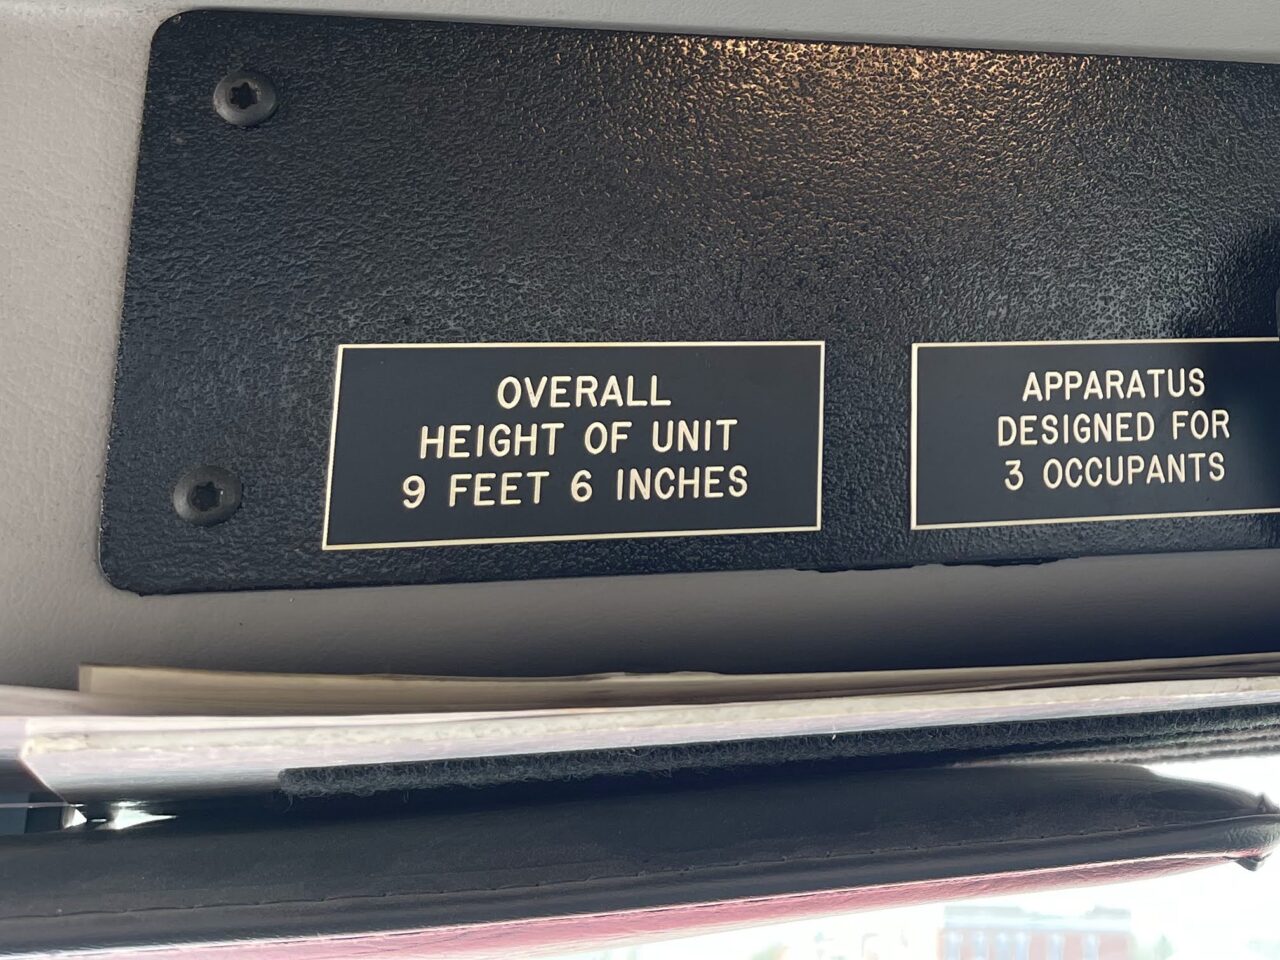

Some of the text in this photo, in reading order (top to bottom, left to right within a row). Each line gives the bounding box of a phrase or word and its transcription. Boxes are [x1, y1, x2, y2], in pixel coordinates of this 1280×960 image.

[496, 374, 672, 410] OVERALL
[1021, 367, 1205, 402] APPARATUS
[419, 419, 738, 460] HEIGHT OF UNIT
[997, 409, 1230, 447] DESIGNED FOR
[402, 464, 748, 509] 9 FEET 6 INCHES
[1004, 451, 1225, 491] 3 OCCUPANTS
